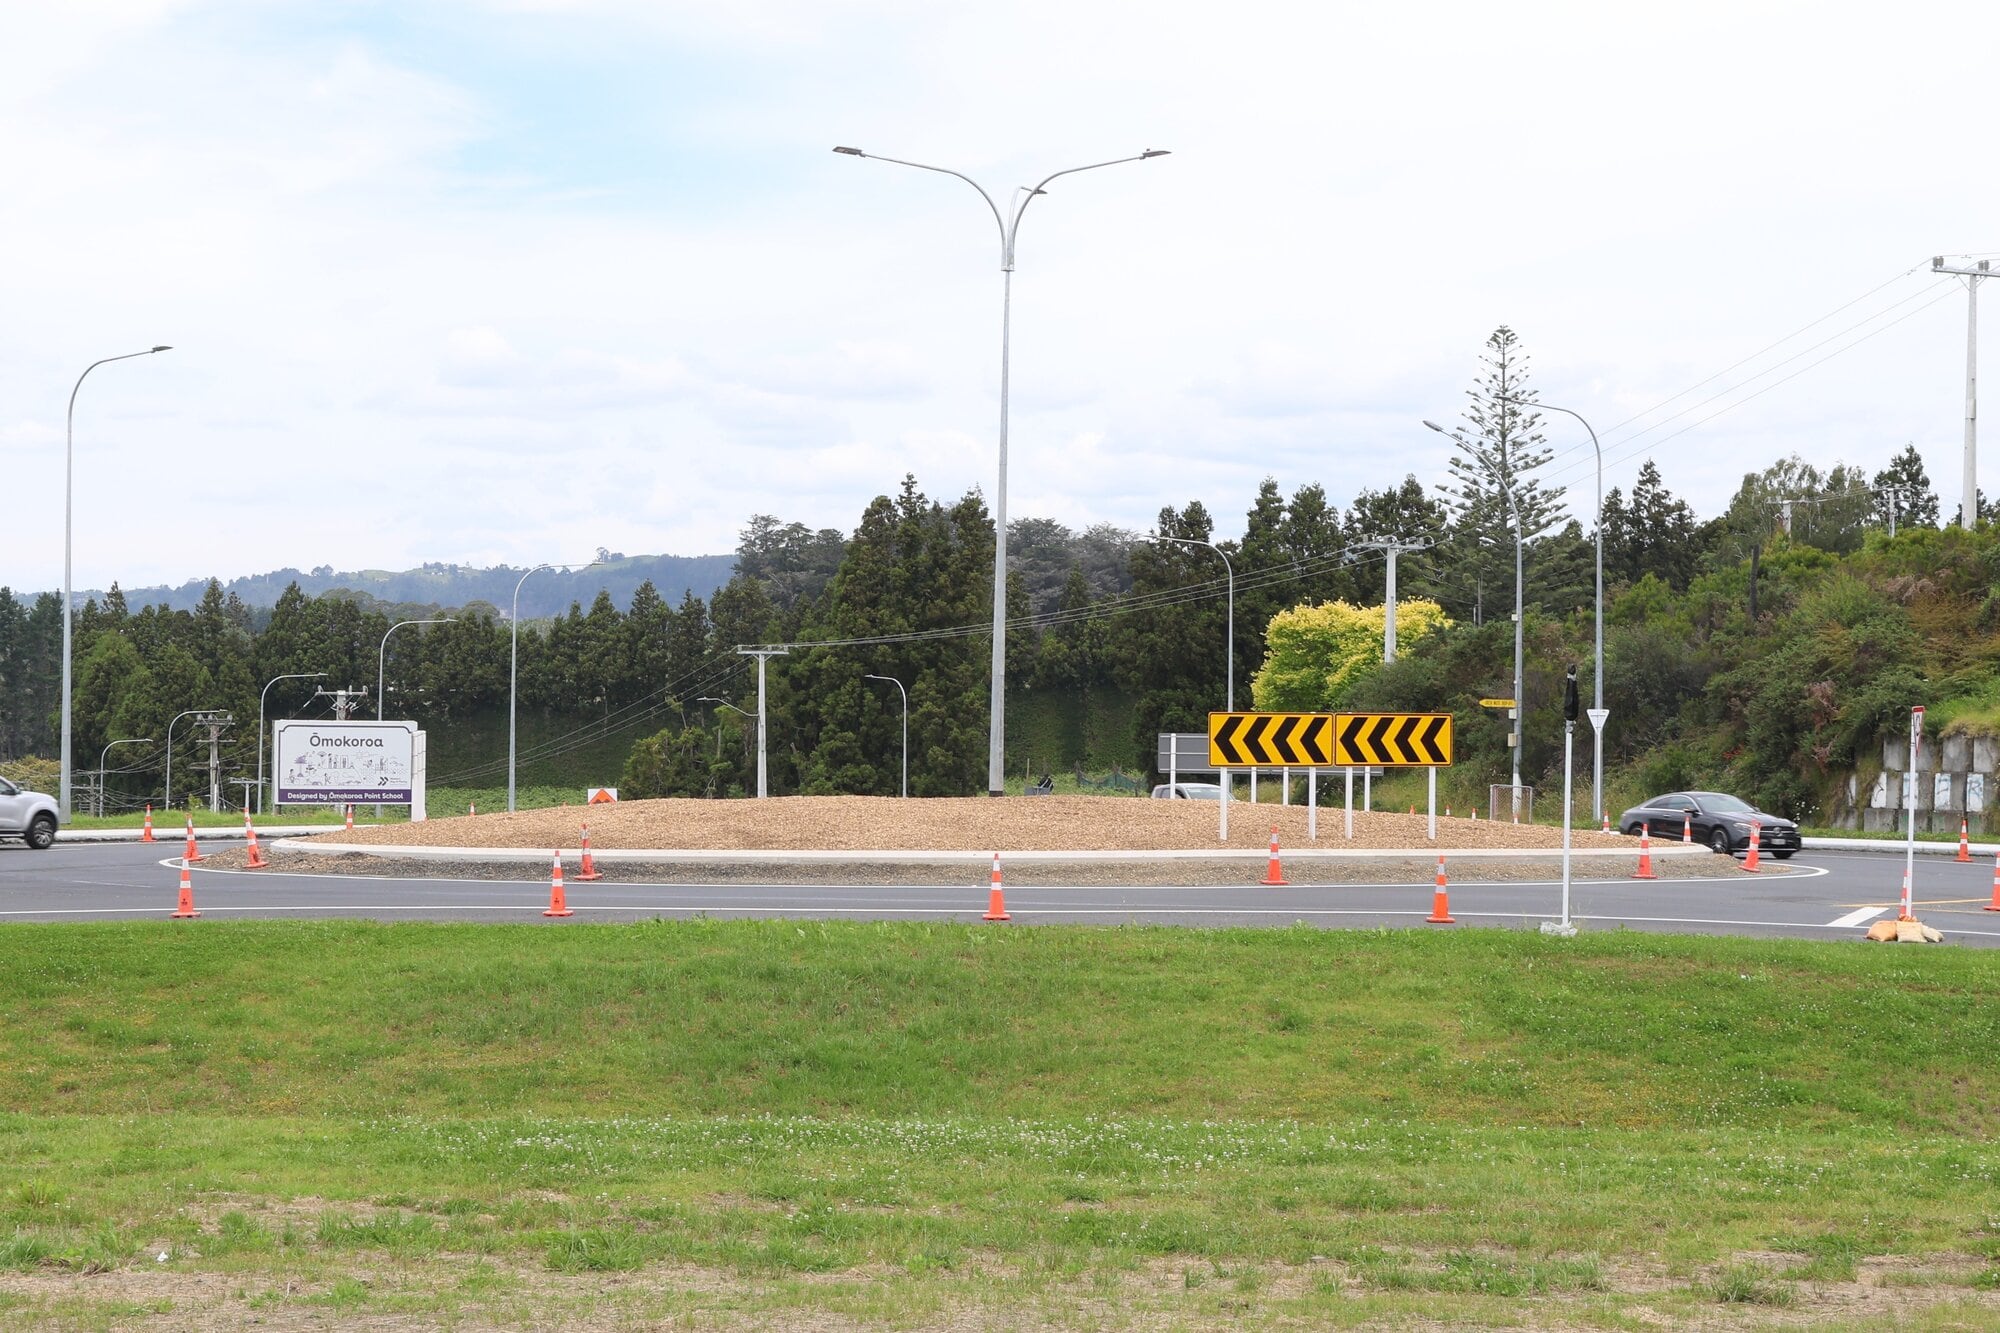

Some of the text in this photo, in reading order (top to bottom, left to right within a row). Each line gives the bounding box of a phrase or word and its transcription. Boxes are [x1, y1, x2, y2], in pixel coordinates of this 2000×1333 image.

[309, 732, 384, 748] Ōmokoroa
[287, 792, 318, 800] Designed
[319, 792, 328, 800] by
